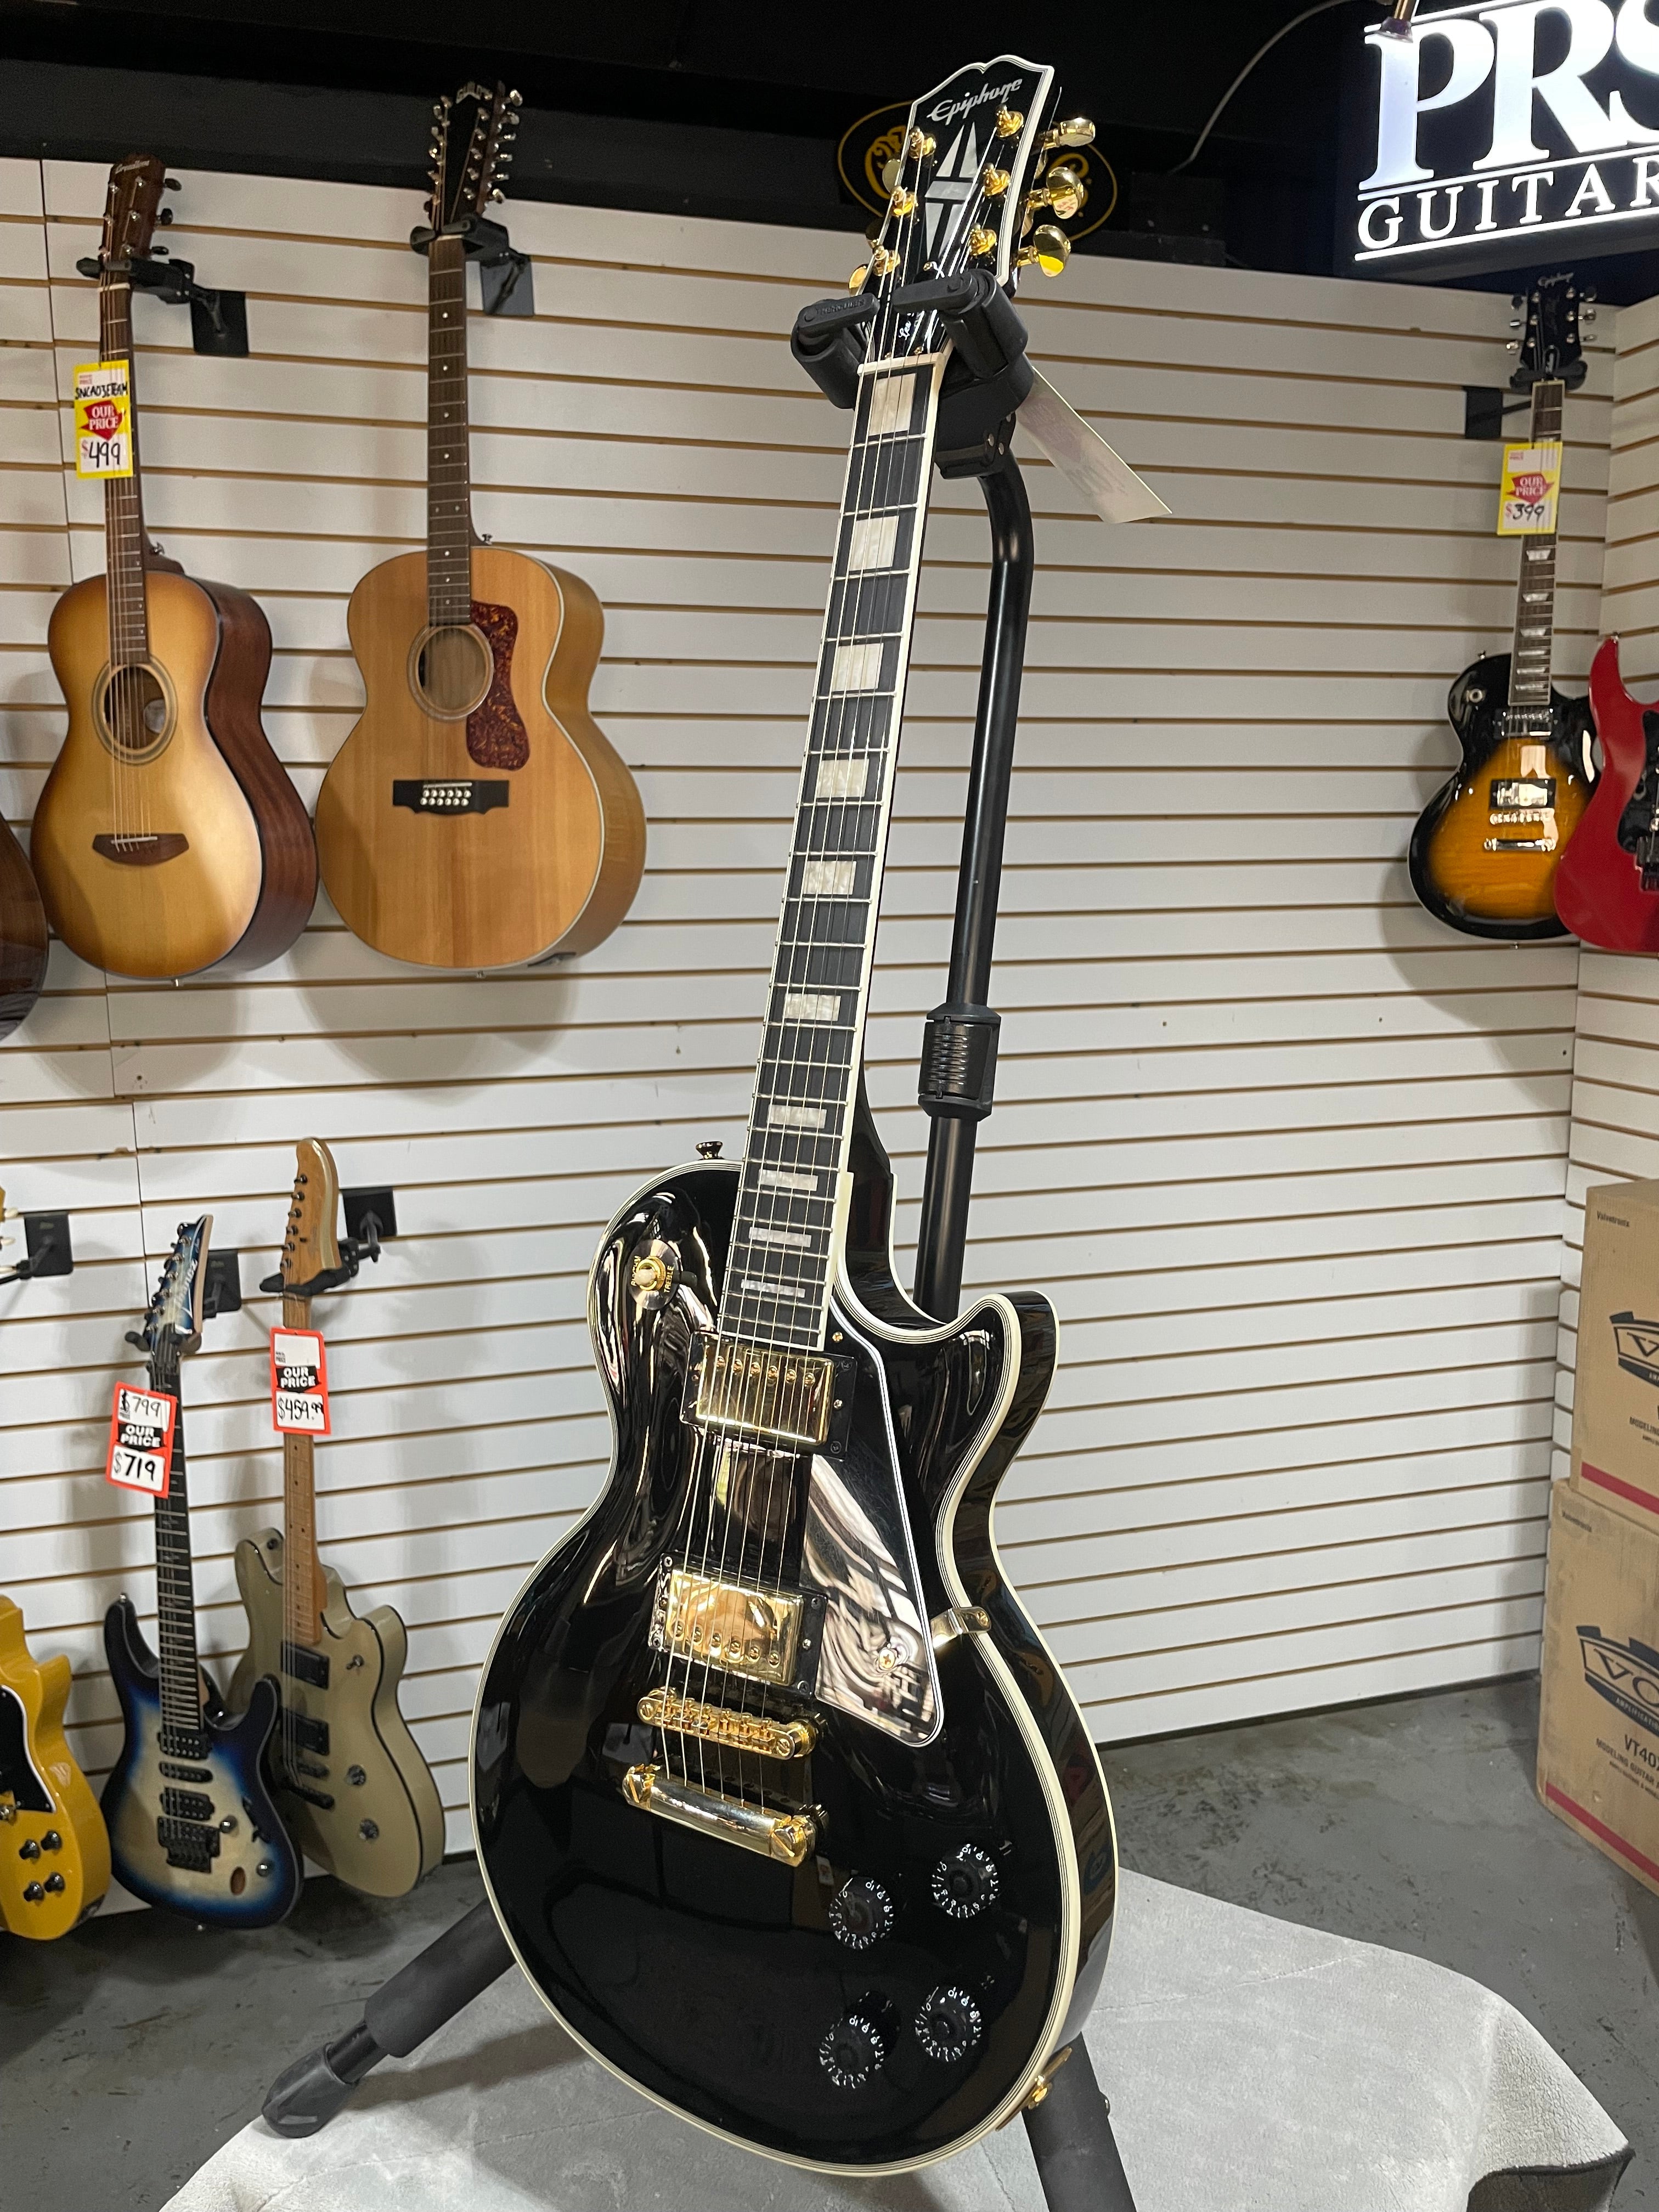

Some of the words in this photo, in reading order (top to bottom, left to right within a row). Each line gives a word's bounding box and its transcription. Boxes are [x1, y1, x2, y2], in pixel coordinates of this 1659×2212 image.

[926, 78, 1023, 126] Epiphone
[92, 404, 115, 419] OUR
[89, 417, 119, 431] PRICE
[82, 440, 121, 468] $499
[1520, 476, 1543, 487] OUR
[1515, 486, 1545, 496] PRICE
[1505, 503, 1545, 522] $399
[663, 1265, 674, 1293] TREBLE
[283, 1366, 309, 1379] OUR
[280, 1375, 316, 1388] PRICE
[126, 1424, 155, 1437] OUR
[120, 1433, 161, 1448] PRICE
[114, 1452, 156, 1482] $719
